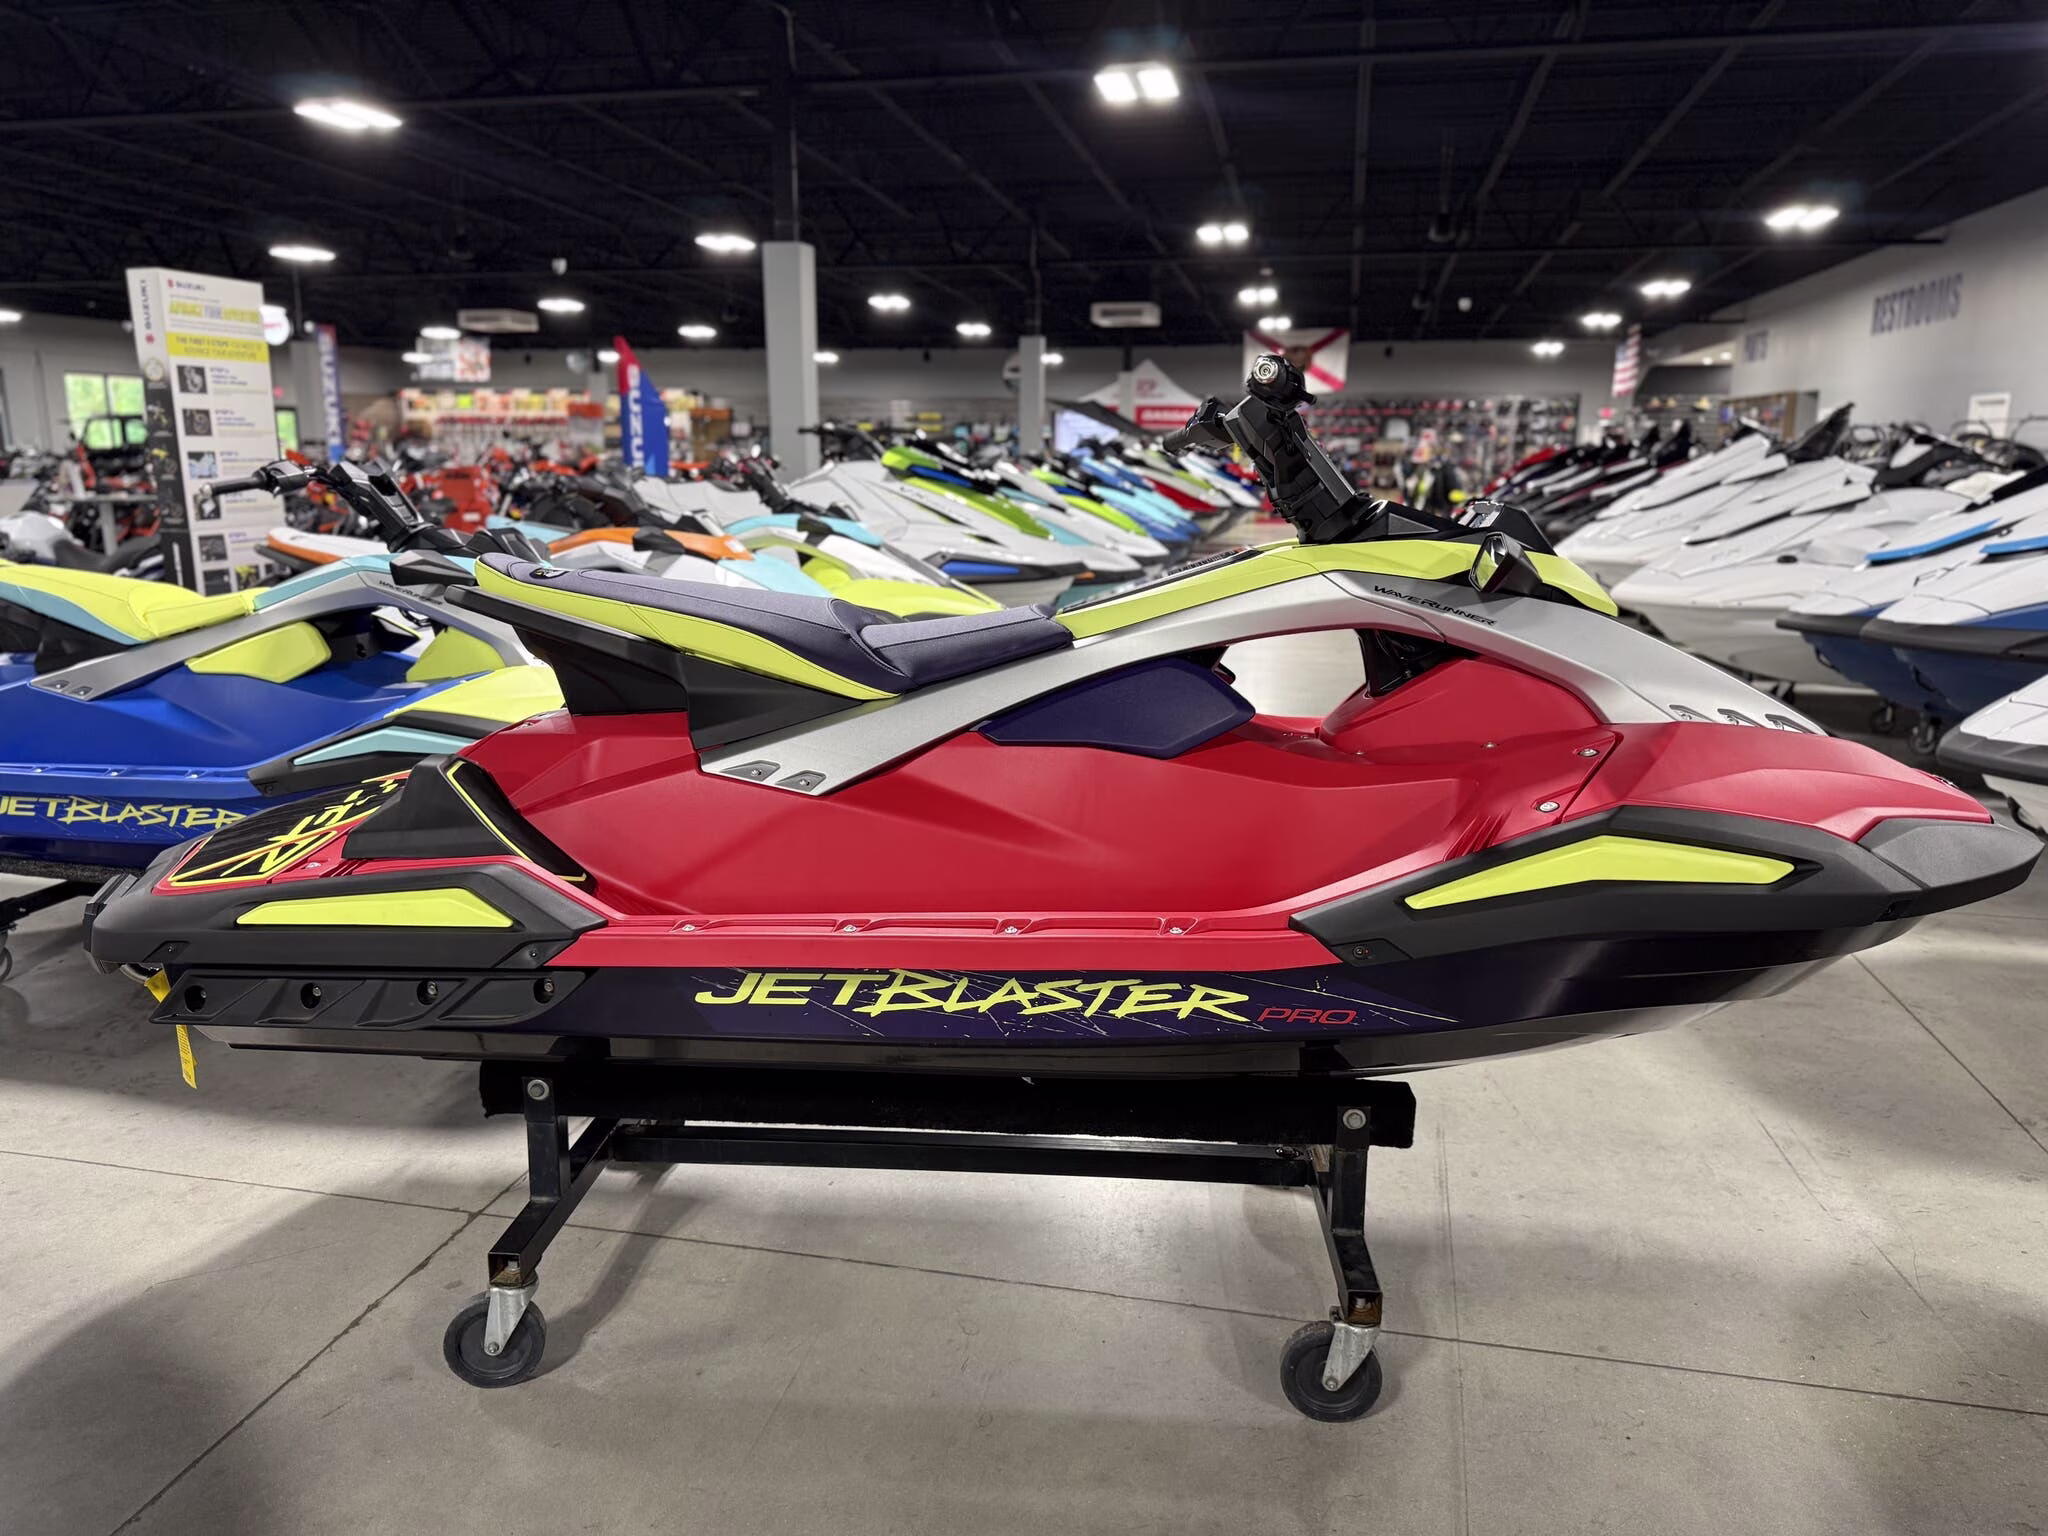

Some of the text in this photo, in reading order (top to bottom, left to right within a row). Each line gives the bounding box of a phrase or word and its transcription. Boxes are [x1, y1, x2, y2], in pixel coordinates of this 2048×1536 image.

[1871, 272, 1963, 335] RESTROOMS
[318, 332, 341, 445] SUZUKI
[627, 364, 644, 467] SUZU
[1374, 585, 1497, 626] WAVERUNNER
[1258, 1007, 1357, 1025] PRO
